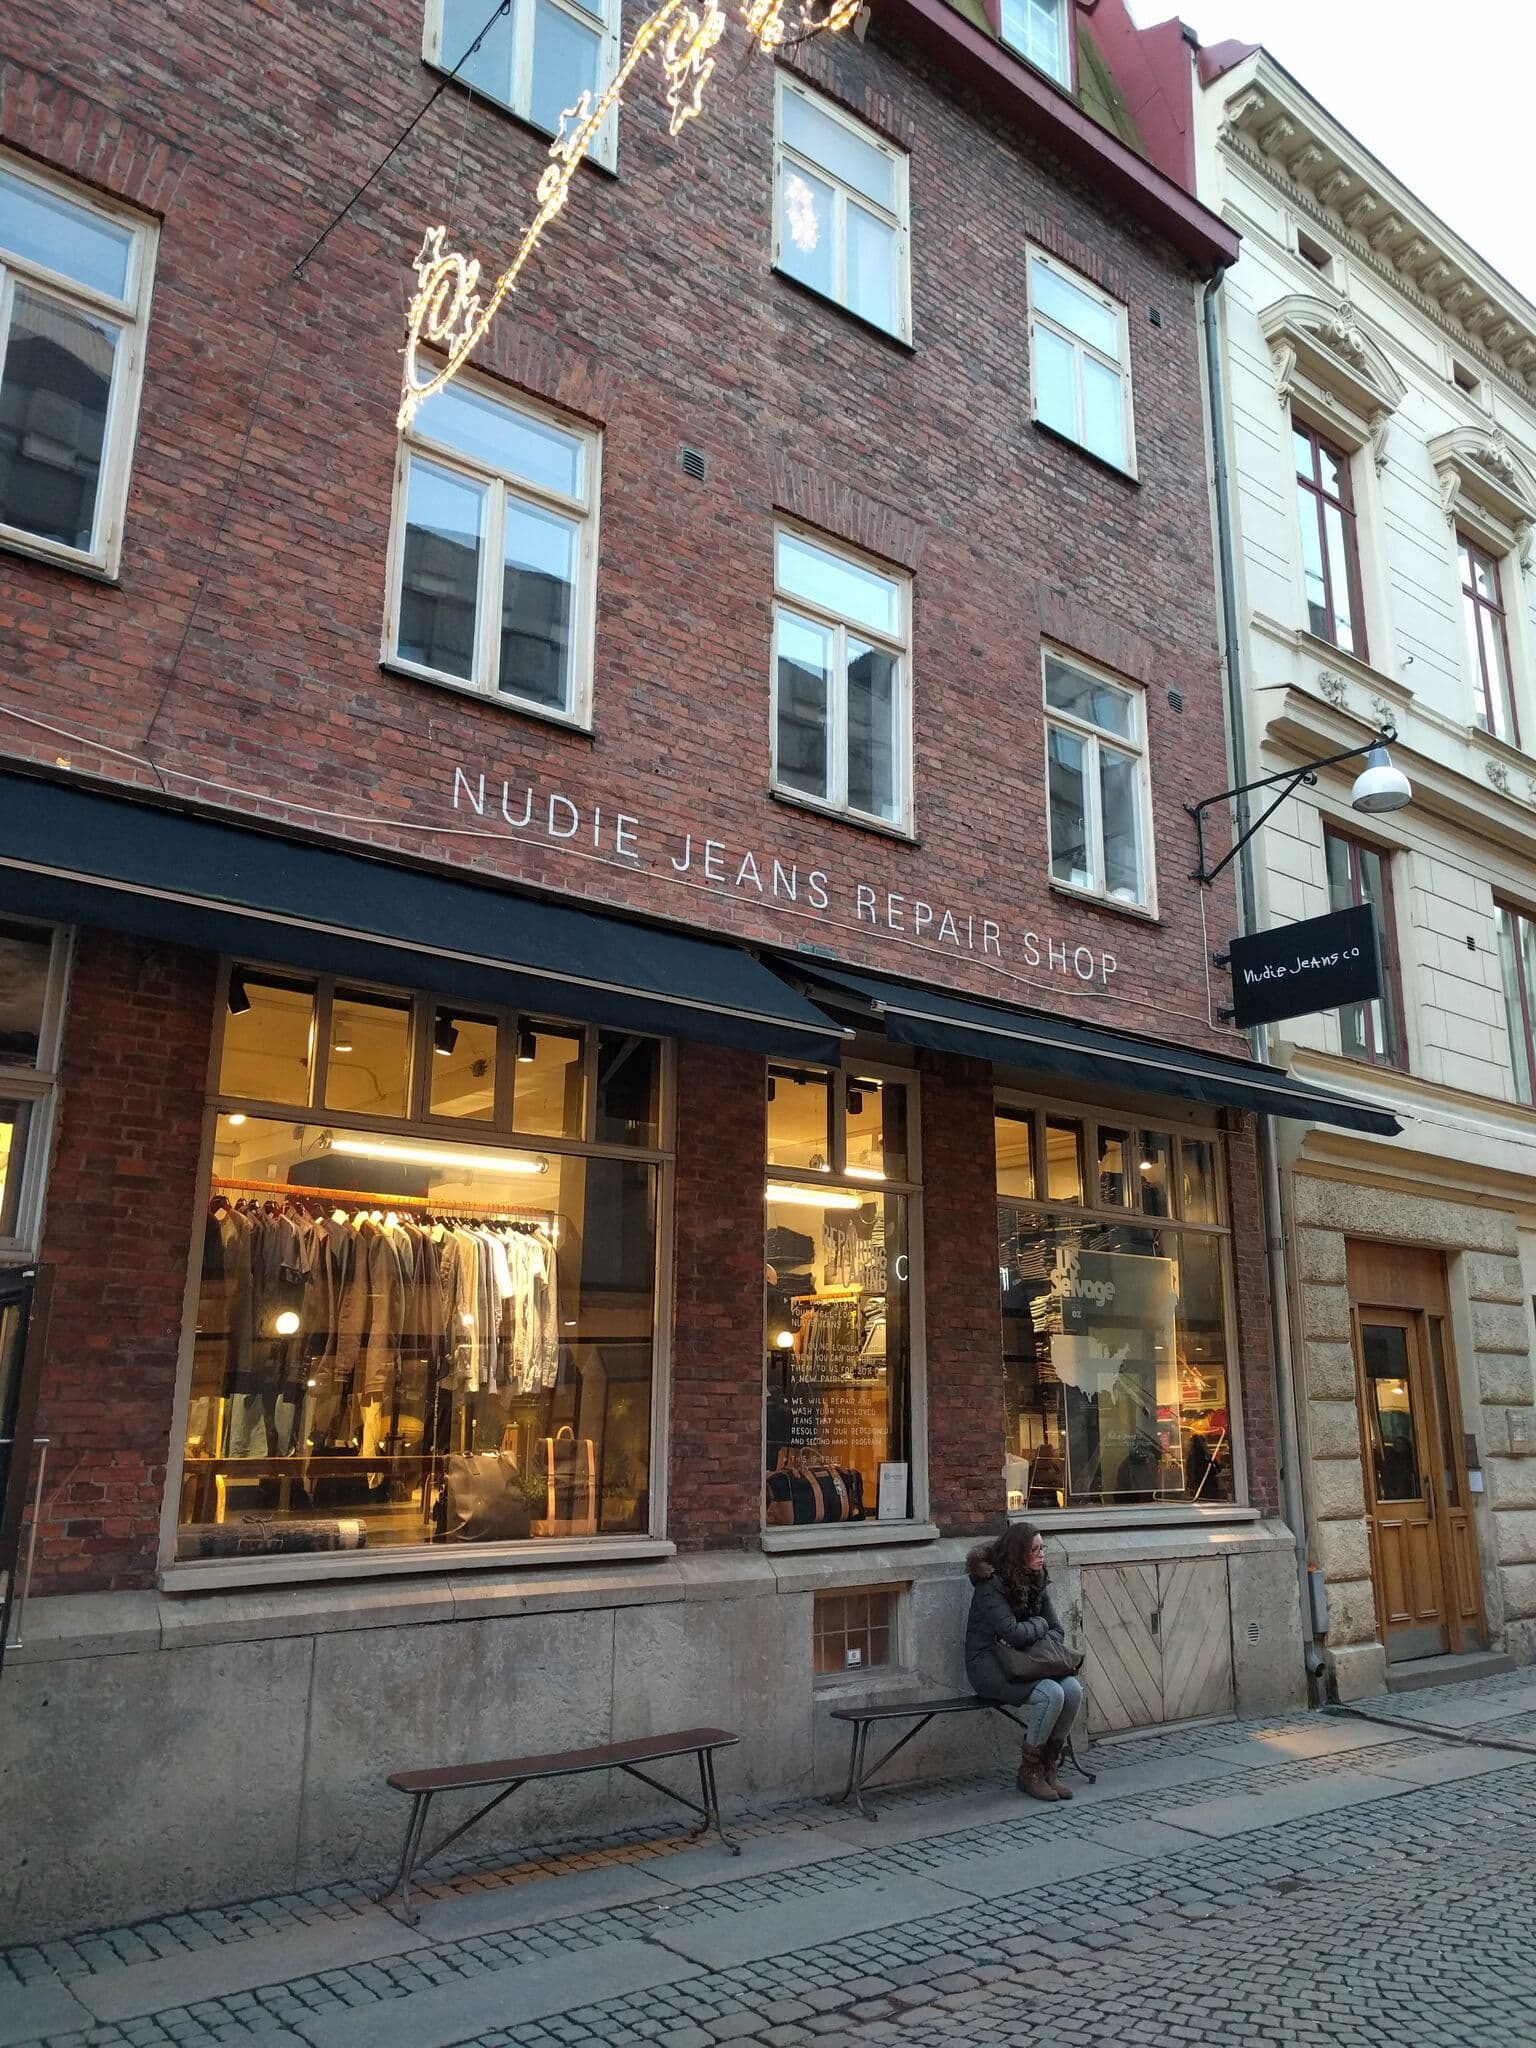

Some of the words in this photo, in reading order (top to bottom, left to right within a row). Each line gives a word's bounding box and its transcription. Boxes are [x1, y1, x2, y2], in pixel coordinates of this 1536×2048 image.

[453, 767, 640, 859] NUDIE
[671, 834, 829, 909] JEANS
[857, 885, 1002, 956] REPAIR
[1023, 933, 1118, 985] SHOP
[1049, 1267, 1116, 1308] Selvage
[791, 1397, 804, 1405] WE
[808, 1397, 826, 1405] WILL
[830, 1397, 856, 1406] REPAIR
[791, 1407, 812, 1416] WASH
[815, 1407, 835, 1416] YOUR
[792, 1417, 813, 1426] JEANS
[815, 1417, 832, 1425] THAT
[791, 1427, 818, 1436] RESOLD
[822, 1427, 830, 1435] IN
[832, 1427, 848, 1436] OUR
[790, 1438, 805, 1446] AND
[806, 1437, 830, 1447] SECOND
